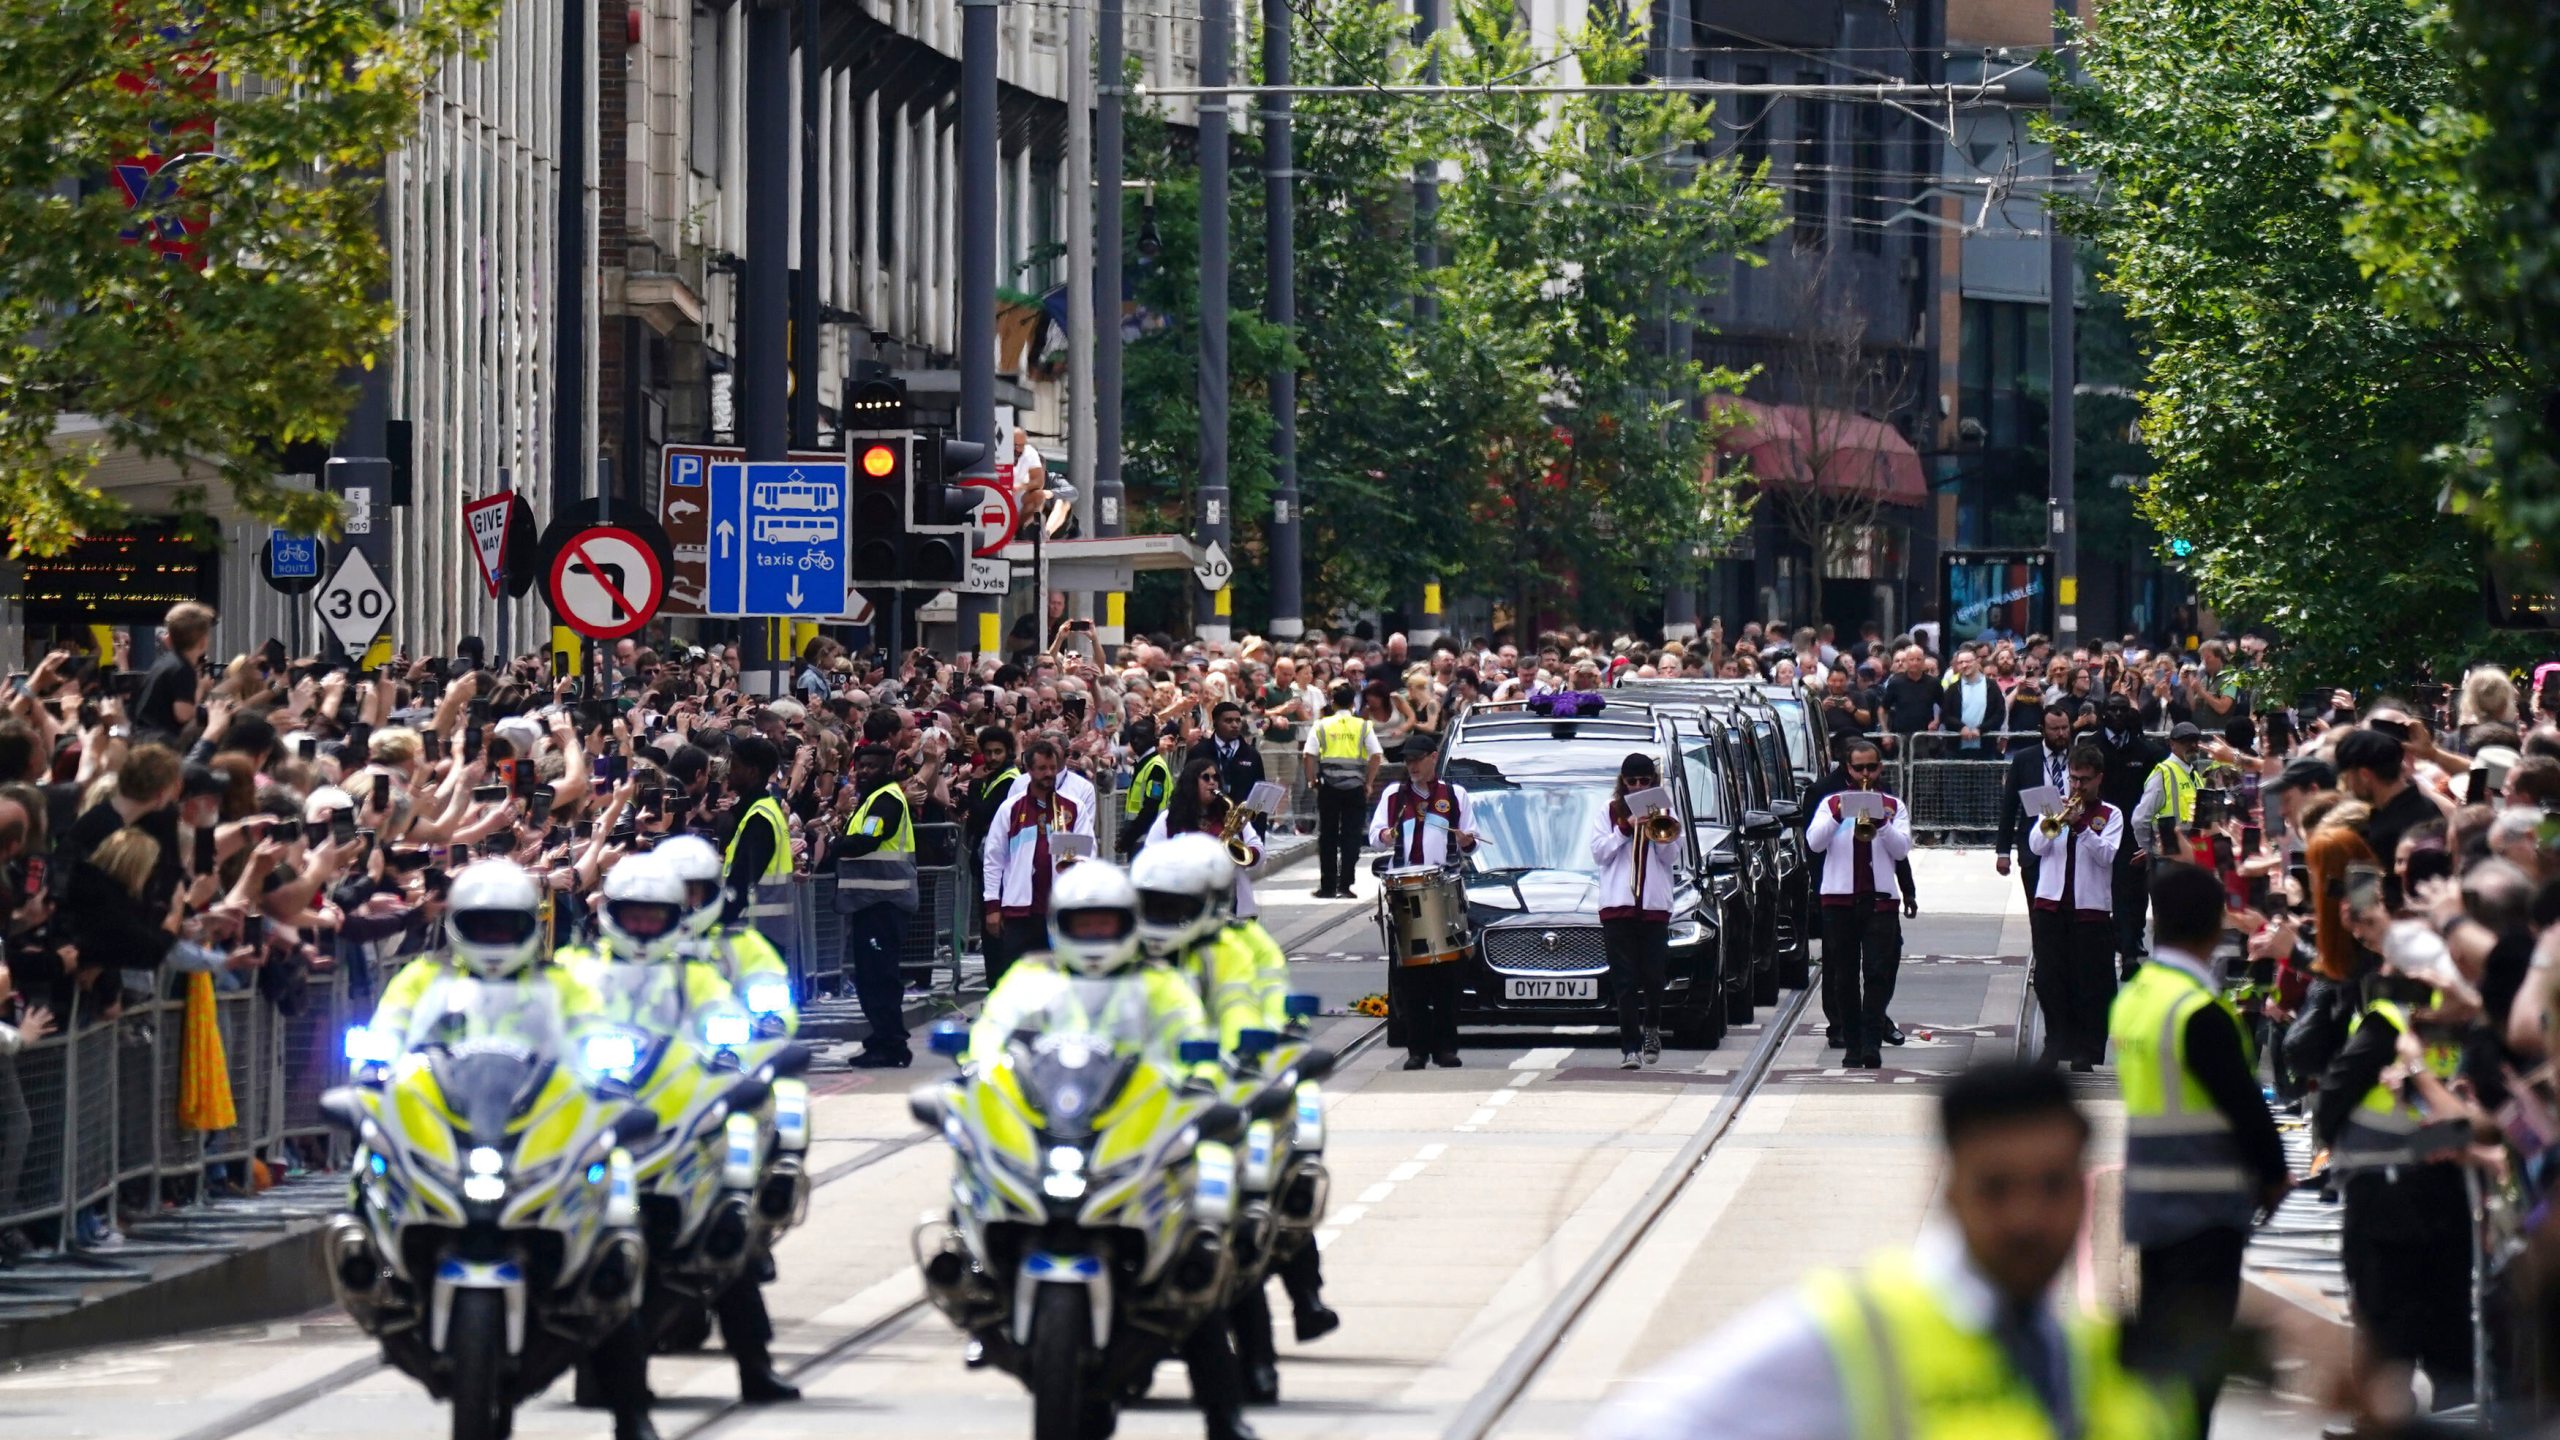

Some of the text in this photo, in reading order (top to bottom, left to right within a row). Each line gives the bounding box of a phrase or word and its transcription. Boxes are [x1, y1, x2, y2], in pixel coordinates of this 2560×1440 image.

[677, 457, 699, 484] P
[347, 522, 368, 532] 909
[473, 508, 503, 534] GIVE
[481, 535, 500, 552] WAY
[756, 552, 794, 567] taxis
[278, 564, 310, 573] ROUTE
[1200, 560, 1227, 577] 30
[983, 577, 1005, 590] yds
[329, 588, 382, 620] 30
[1515, 981, 1588, 997] OY17 DVJ
